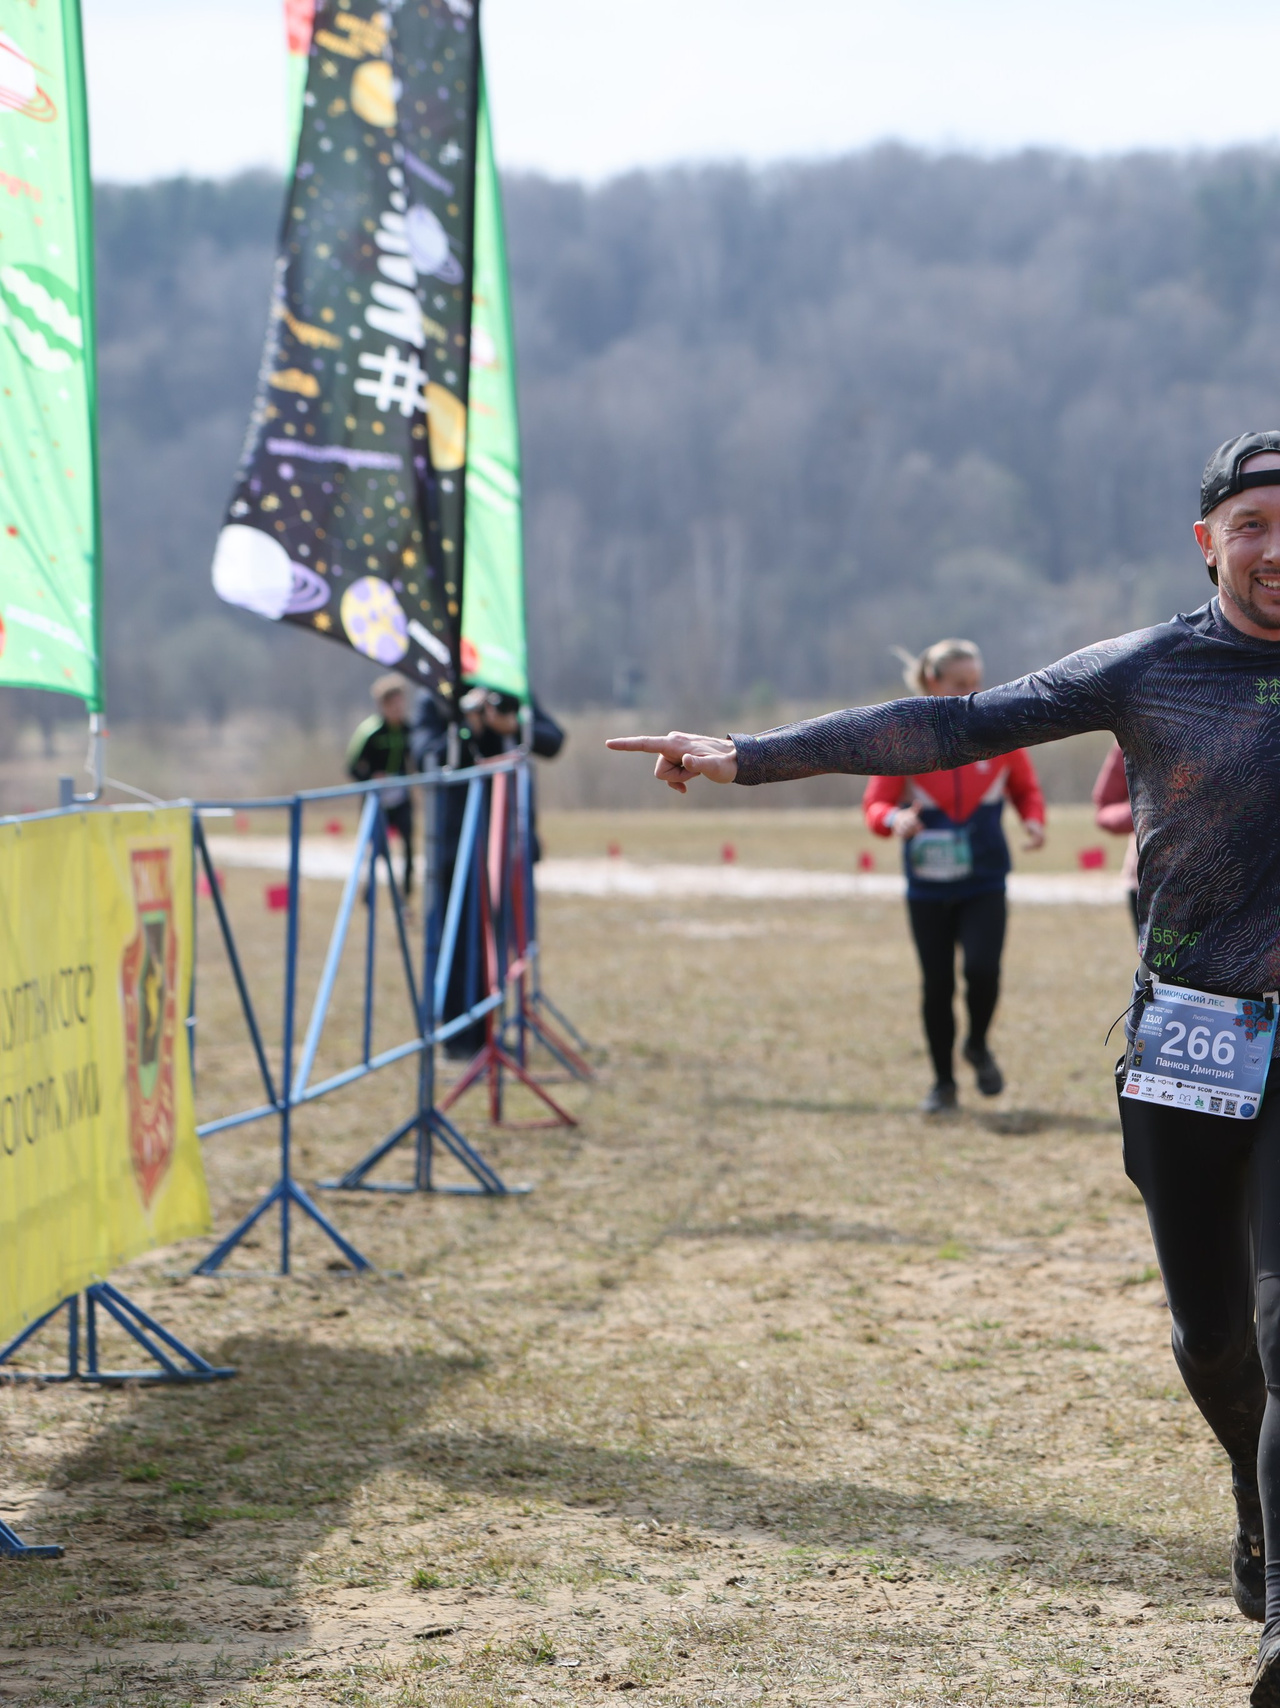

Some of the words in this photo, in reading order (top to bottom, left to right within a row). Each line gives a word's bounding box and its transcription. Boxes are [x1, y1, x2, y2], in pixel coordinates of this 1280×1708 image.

[1154, 988, 1206, 1004] ХИМКИНСКИЙ
[1207, 998, 1225, 1007] ЛЕС
[1160, 1021, 1237, 1065] 266
[1155, 1057, 1190, 1071] Панков
[1191, 1064, 1235, 1079] Дмитрий
